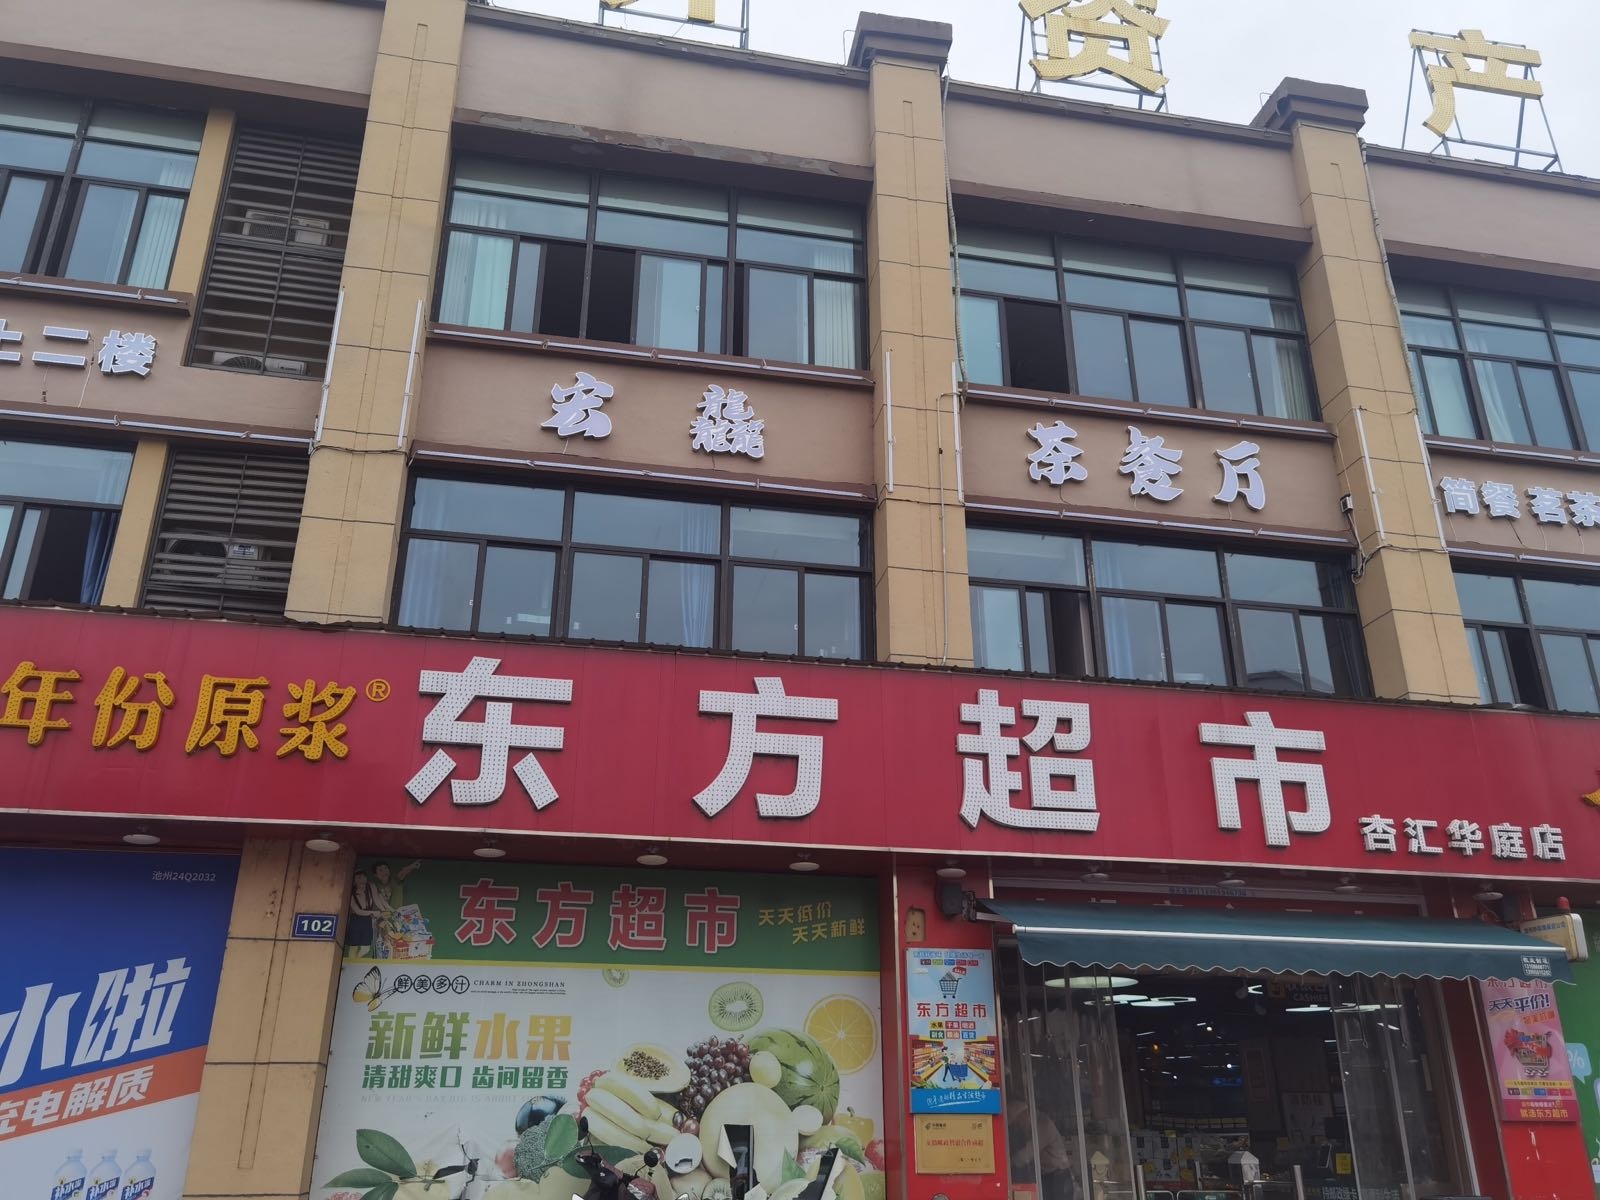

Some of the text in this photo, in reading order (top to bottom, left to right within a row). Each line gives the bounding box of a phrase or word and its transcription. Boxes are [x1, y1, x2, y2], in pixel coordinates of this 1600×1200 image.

[1026, 420, 1266, 511] 茶餐厅
[405, 656, 1332, 847] 东方超市
[1358, 814, 1566, 861] 杏汇华庭店
[151, 870, 217, 883] 池州24Q2032
[300, 919, 333, 933] 102
[455, 878, 741, 954] 东方超市
[758, 901, 833, 927] 天天低价
[792, 917, 866, 945] 天天新鲜
[395, 974, 469, 994] 鲜美多汁
[473, 979, 502, 987] CHARM
[916, 1002, 988, 1018] 东方超市
[1488, 993, 1550, 1012] 天天平价!
[364, 1011, 572, 1061] 新鲜水果
[361, 1064, 569, 1089] 清甜爽口 齿间留香
